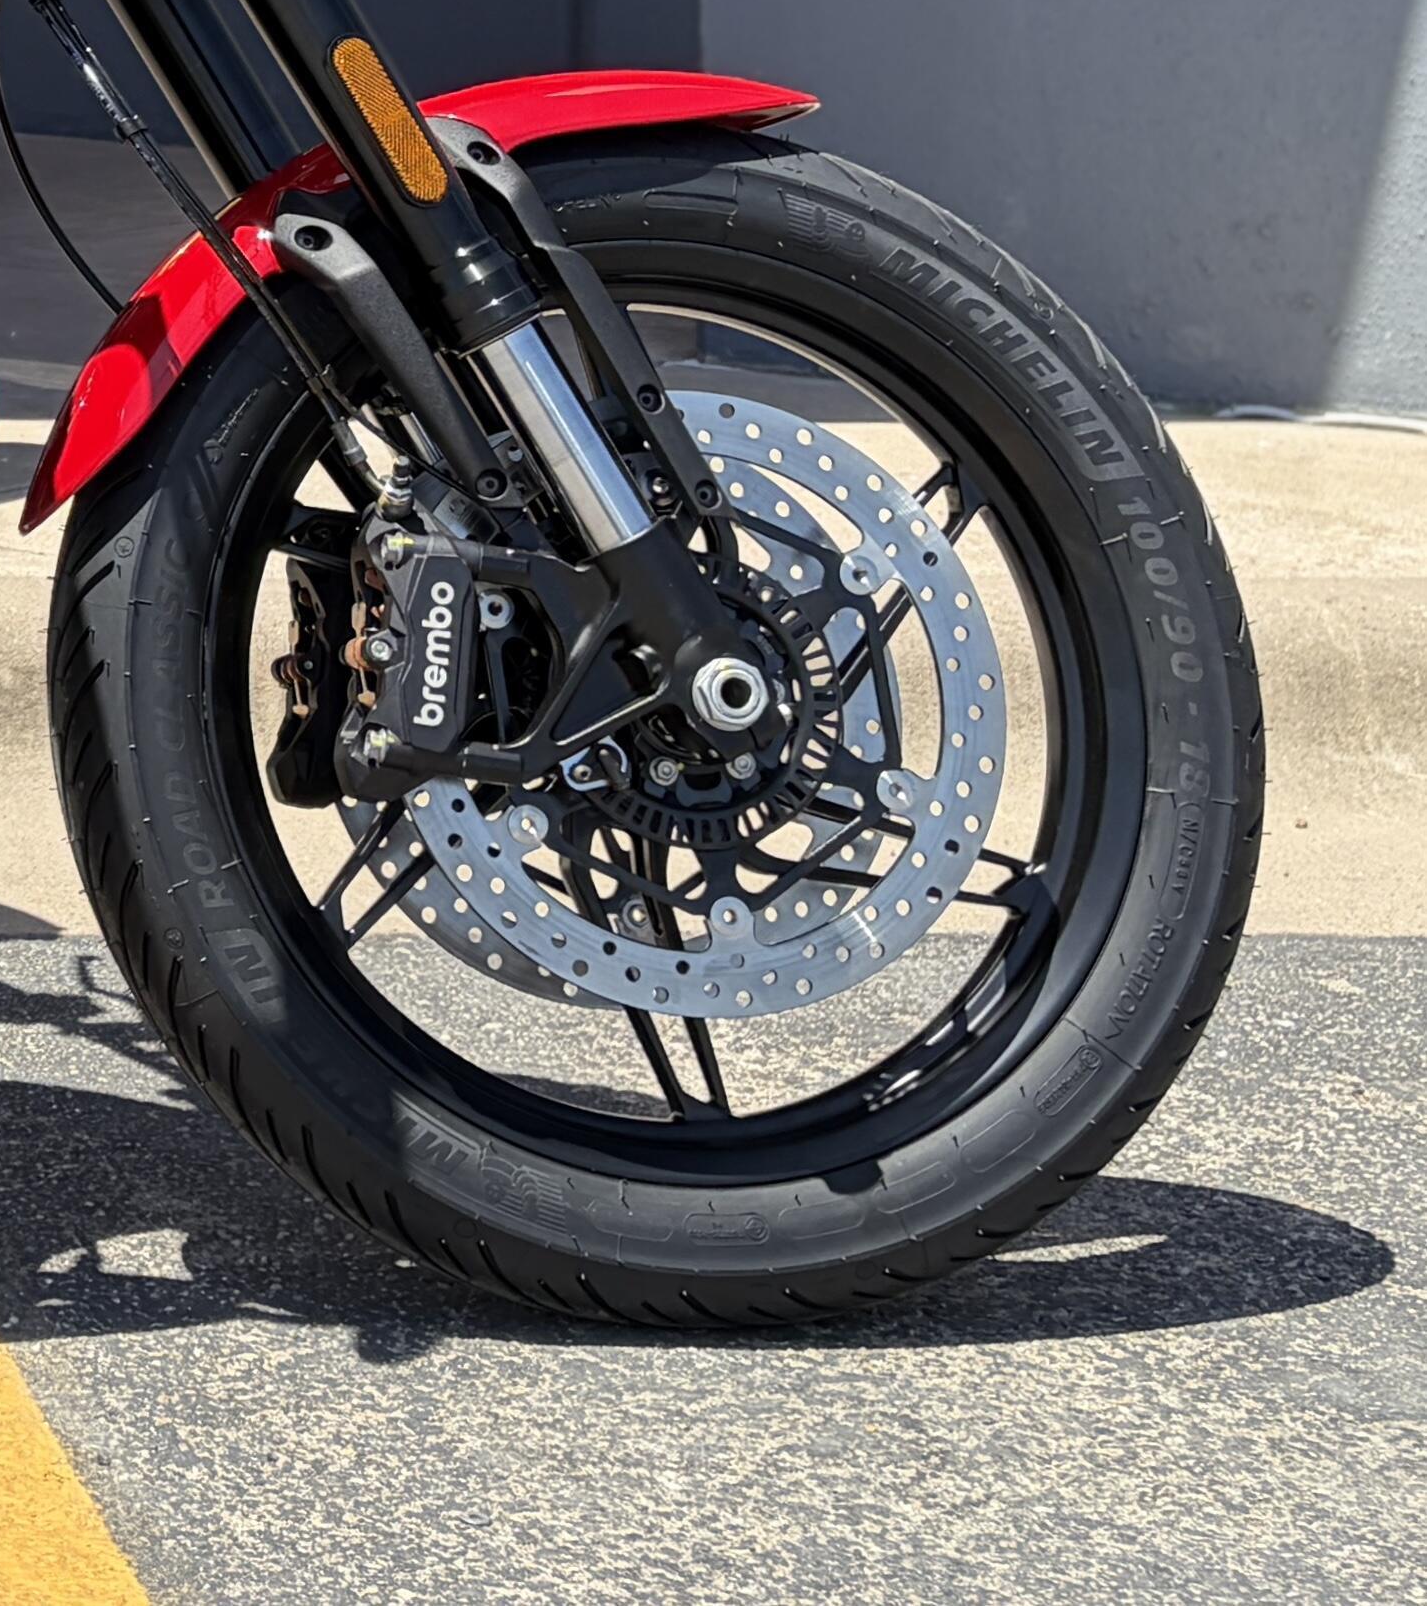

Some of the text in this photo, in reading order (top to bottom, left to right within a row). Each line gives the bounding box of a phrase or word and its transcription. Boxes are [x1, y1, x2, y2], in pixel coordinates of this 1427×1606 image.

[878, 247, 1127, 471] MICHELIN
[1116, 496, 1204, 683] 100/90
[1179, 739, 1212, 800] 18
[413, 581, 455, 727] brembo
[162, 770, 237, 911] ROAD
[224, 942, 471, 1175] MICHEIN
